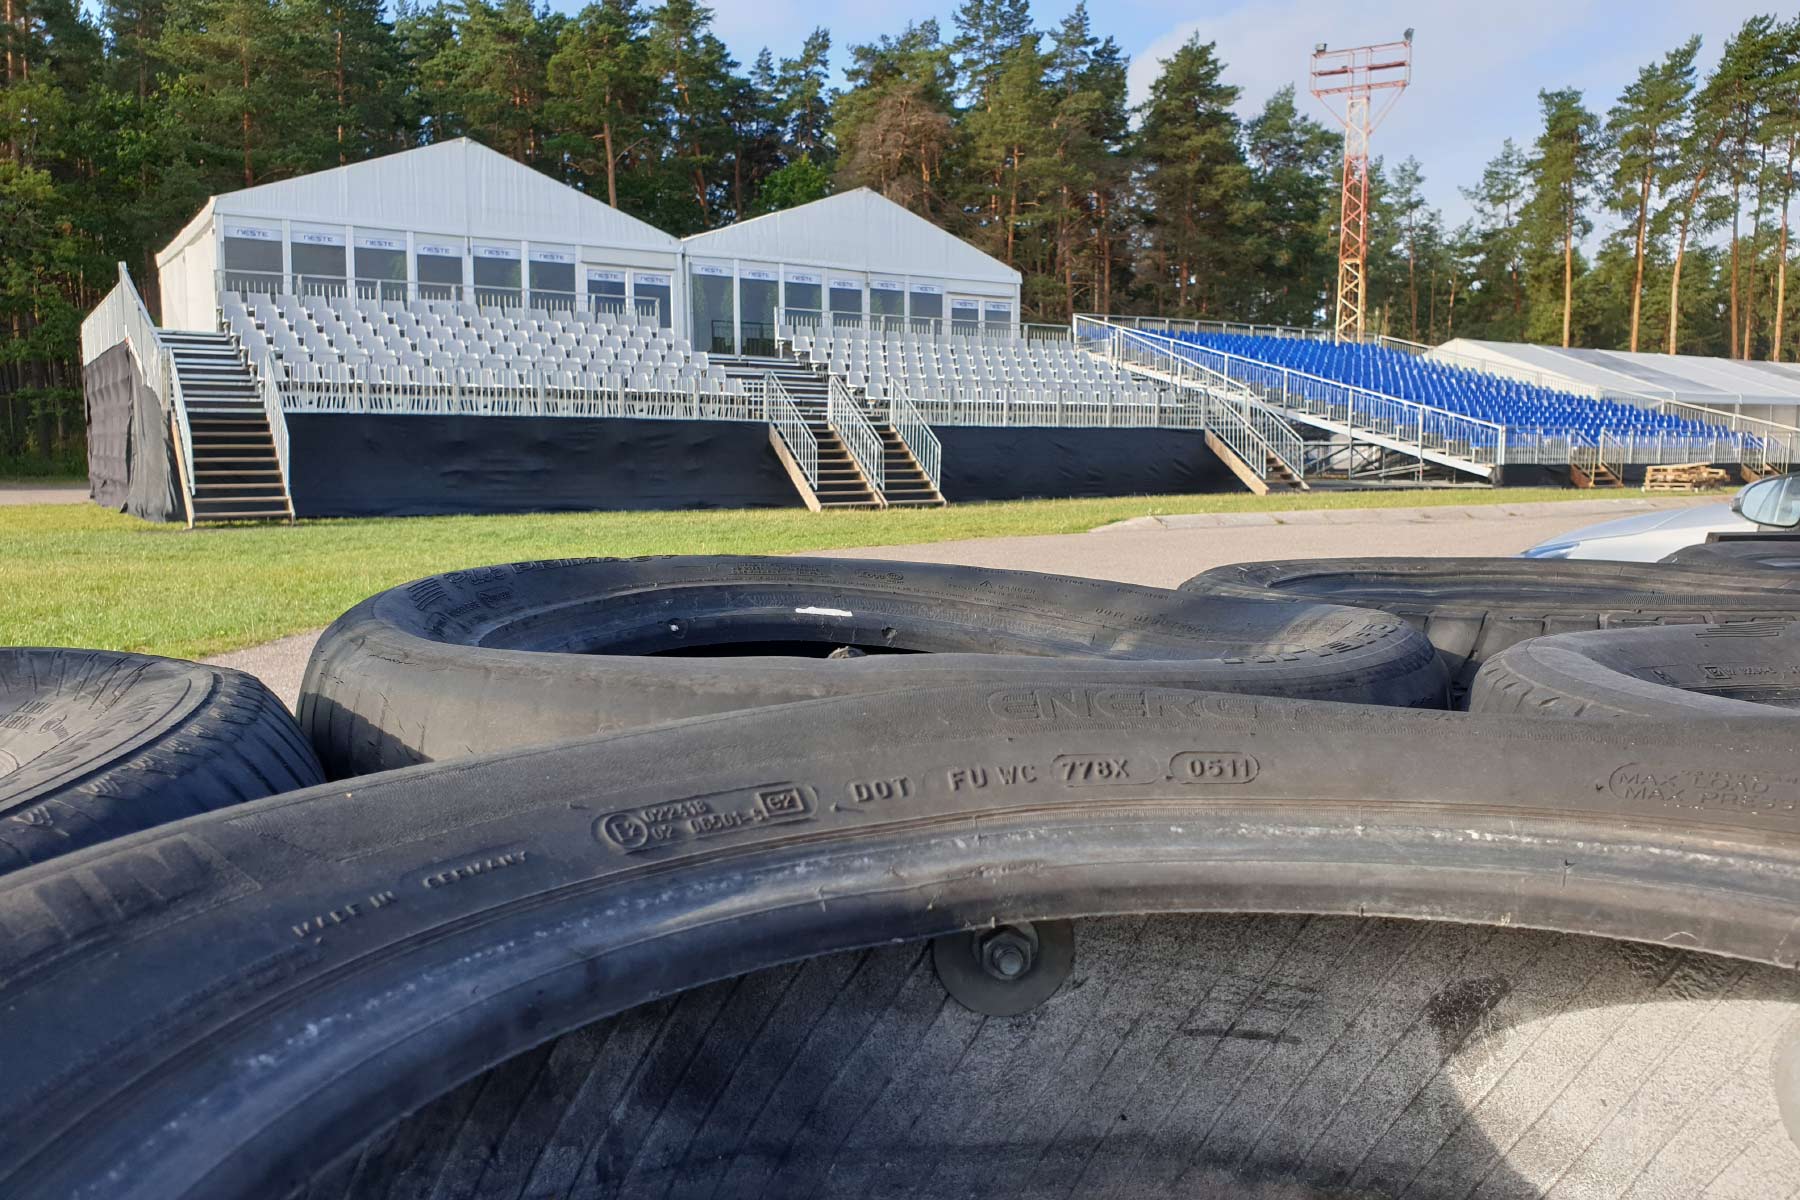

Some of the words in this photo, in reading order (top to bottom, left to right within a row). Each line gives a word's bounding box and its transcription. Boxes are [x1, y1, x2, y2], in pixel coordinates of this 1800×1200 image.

[852, 777, 908, 802] DOT
[1061, 758, 1130, 781] 778X
[1187, 758, 1251, 778] 0511
[1619, 772, 1678, 788] MAX
